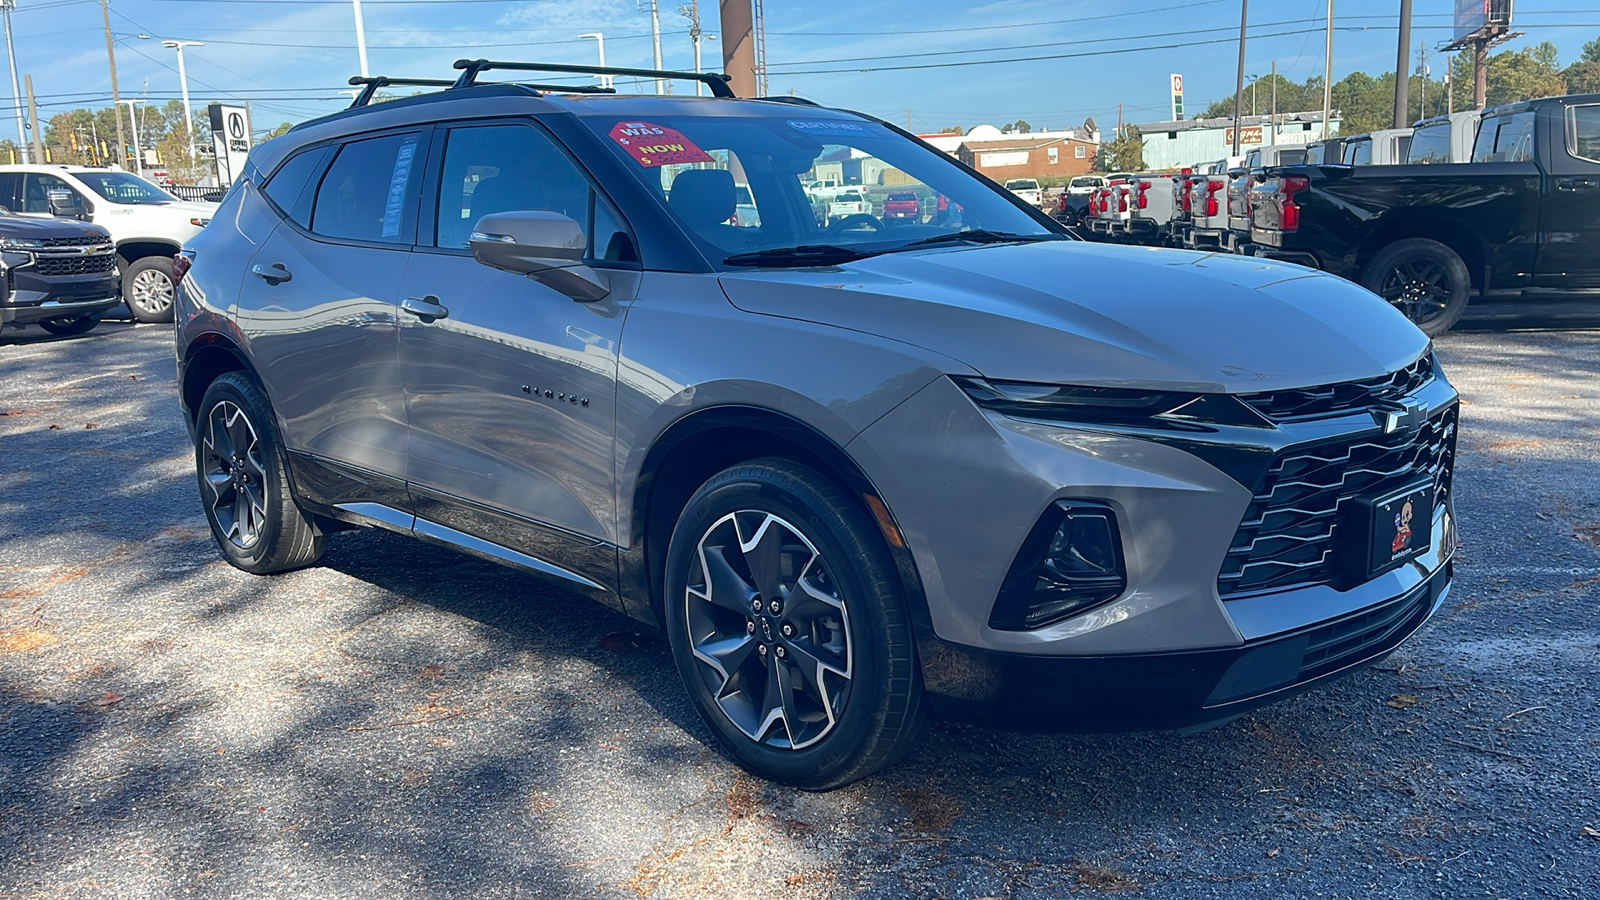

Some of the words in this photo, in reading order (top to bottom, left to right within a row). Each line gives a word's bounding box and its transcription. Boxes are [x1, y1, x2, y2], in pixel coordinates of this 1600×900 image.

[789, 121, 863, 131] CERTIFIED
[619, 127, 664, 136] WAS
[638, 143, 685, 154] NOW
[641, 157, 652, 165] $
[522, 384, 589, 408] BLAZER
